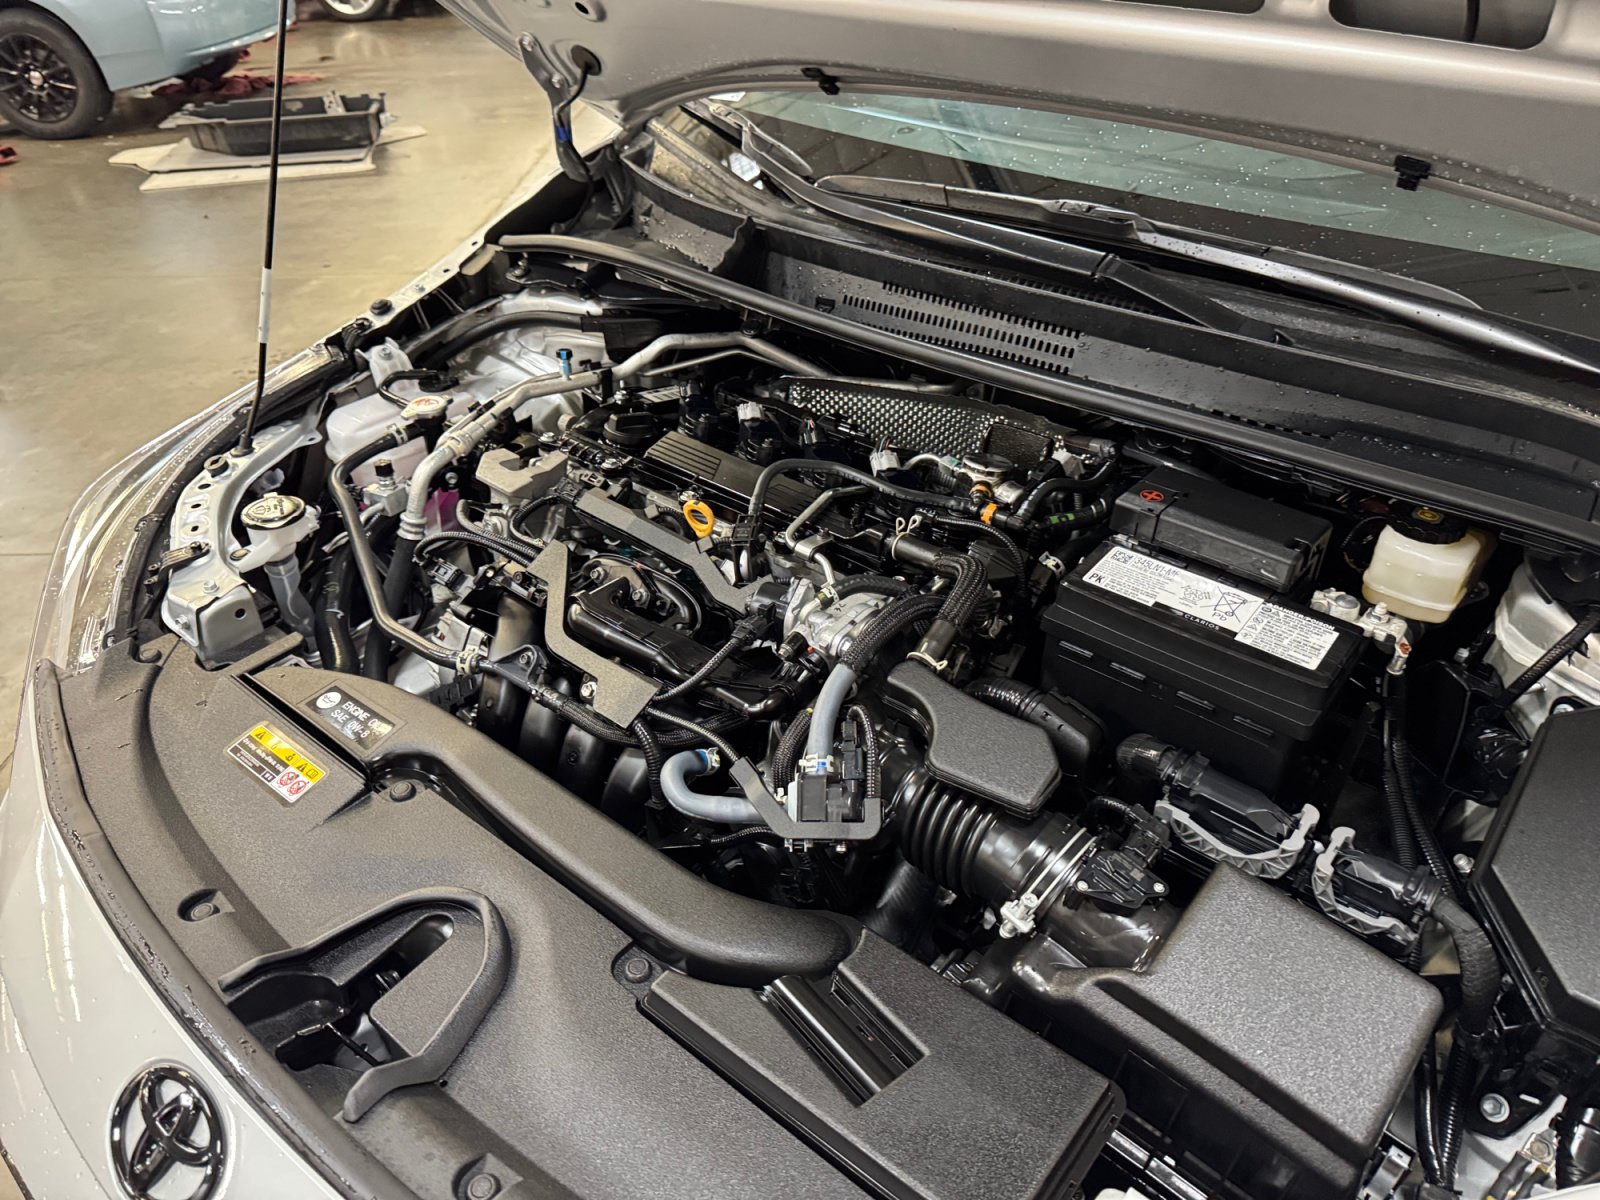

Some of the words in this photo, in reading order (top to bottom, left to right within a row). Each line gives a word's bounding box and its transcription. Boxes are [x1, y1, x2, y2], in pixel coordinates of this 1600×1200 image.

[1088, 572, 1106, 584] PK
[1184, 613, 1220, 631] CLARIOS
[1211, 611, 1228, 622] Pb
[341, 700, 371, 722] ENGINE
[330, 709, 350, 723] SAE
[348, 720, 371, 738] 0W-8
